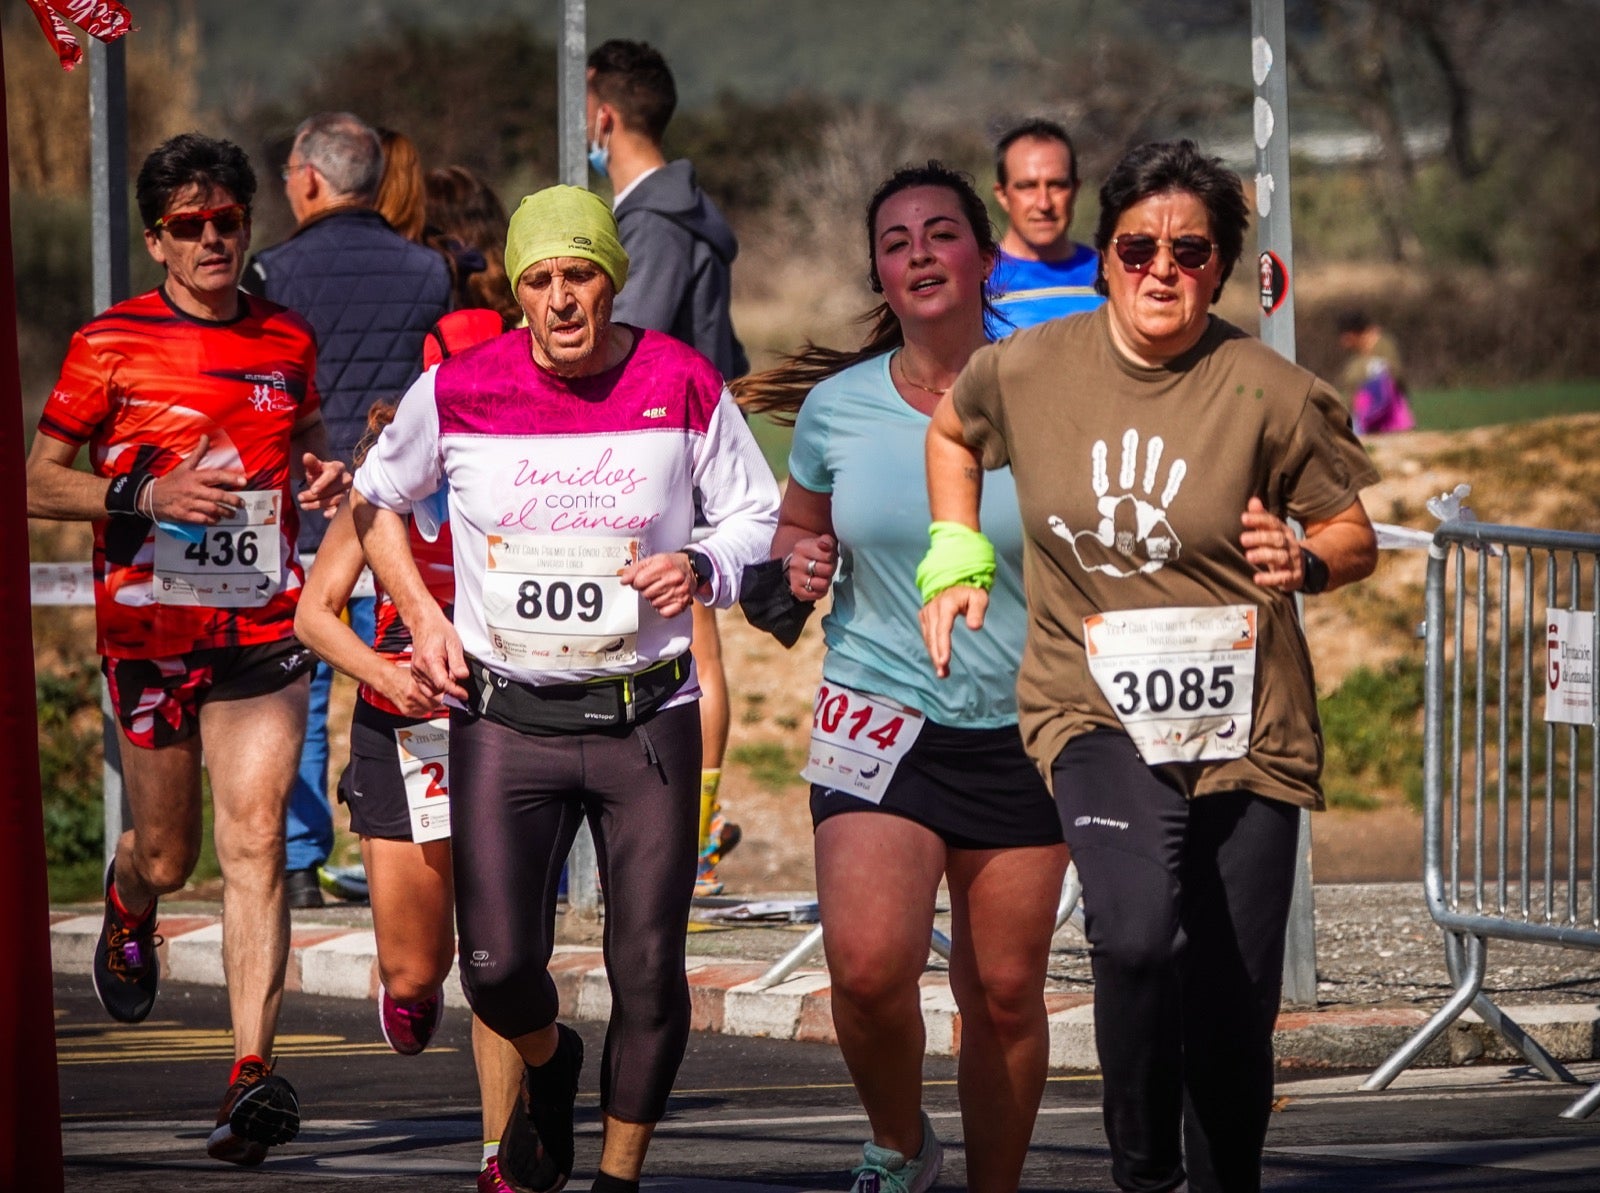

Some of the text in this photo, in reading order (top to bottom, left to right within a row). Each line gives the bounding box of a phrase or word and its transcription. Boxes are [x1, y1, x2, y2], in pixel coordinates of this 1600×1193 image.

[514, 447, 647, 495] Unidos
[497, 498, 660, 532] el cáncer
[545, 491, 616, 509] contra
[184, 530, 259, 567] 436
[516, 579, 603, 623] 809
[1112, 665, 1235, 716] 3085
